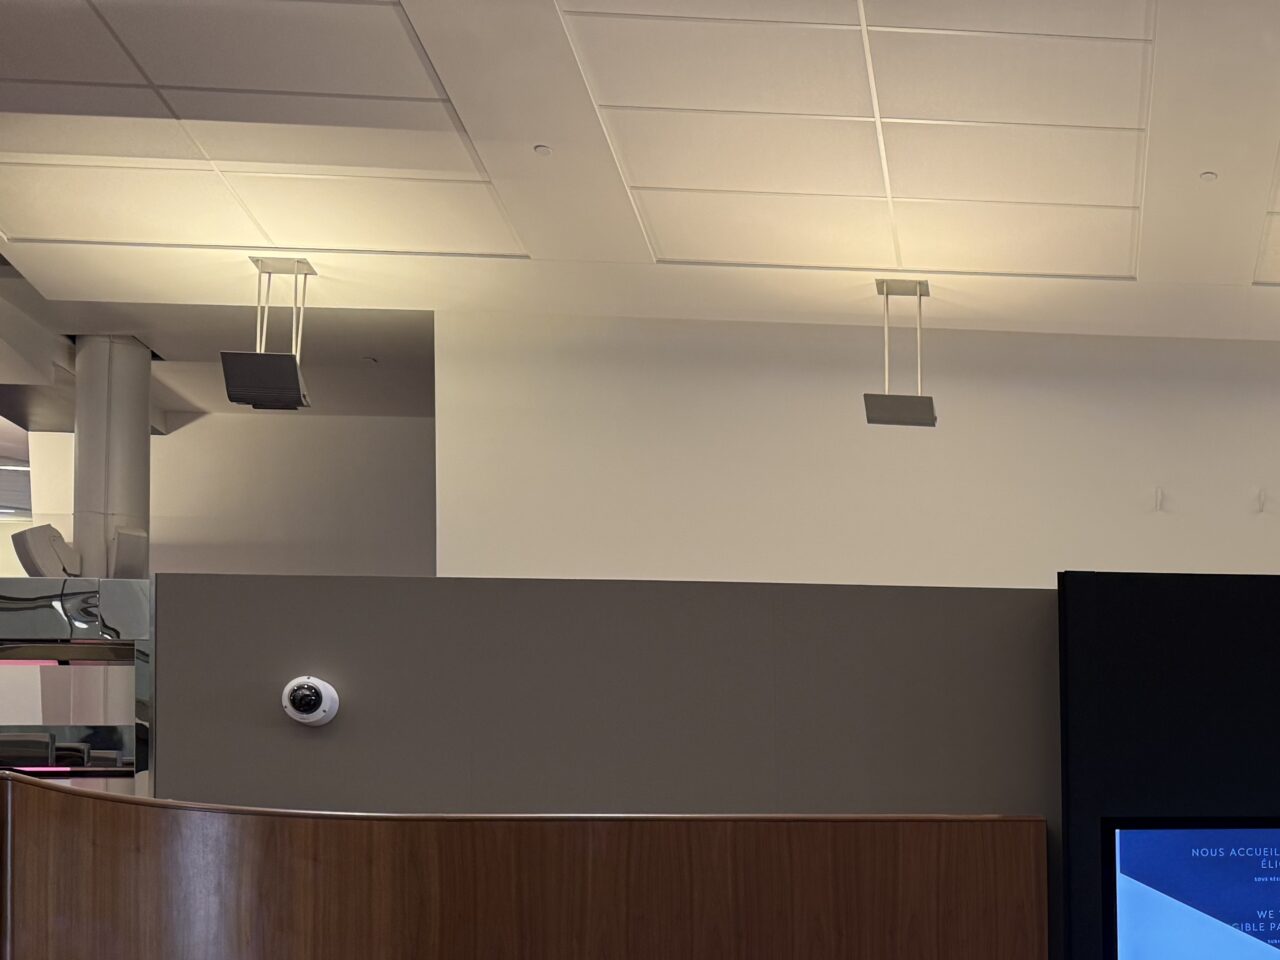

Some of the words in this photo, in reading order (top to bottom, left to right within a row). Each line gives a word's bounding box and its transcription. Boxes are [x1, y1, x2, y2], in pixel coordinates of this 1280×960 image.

[1191, 848, 1225, 857] NOUS
[1257, 910, 1274, 919] WE
[1231, 922, 1265, 932] GIBLE
